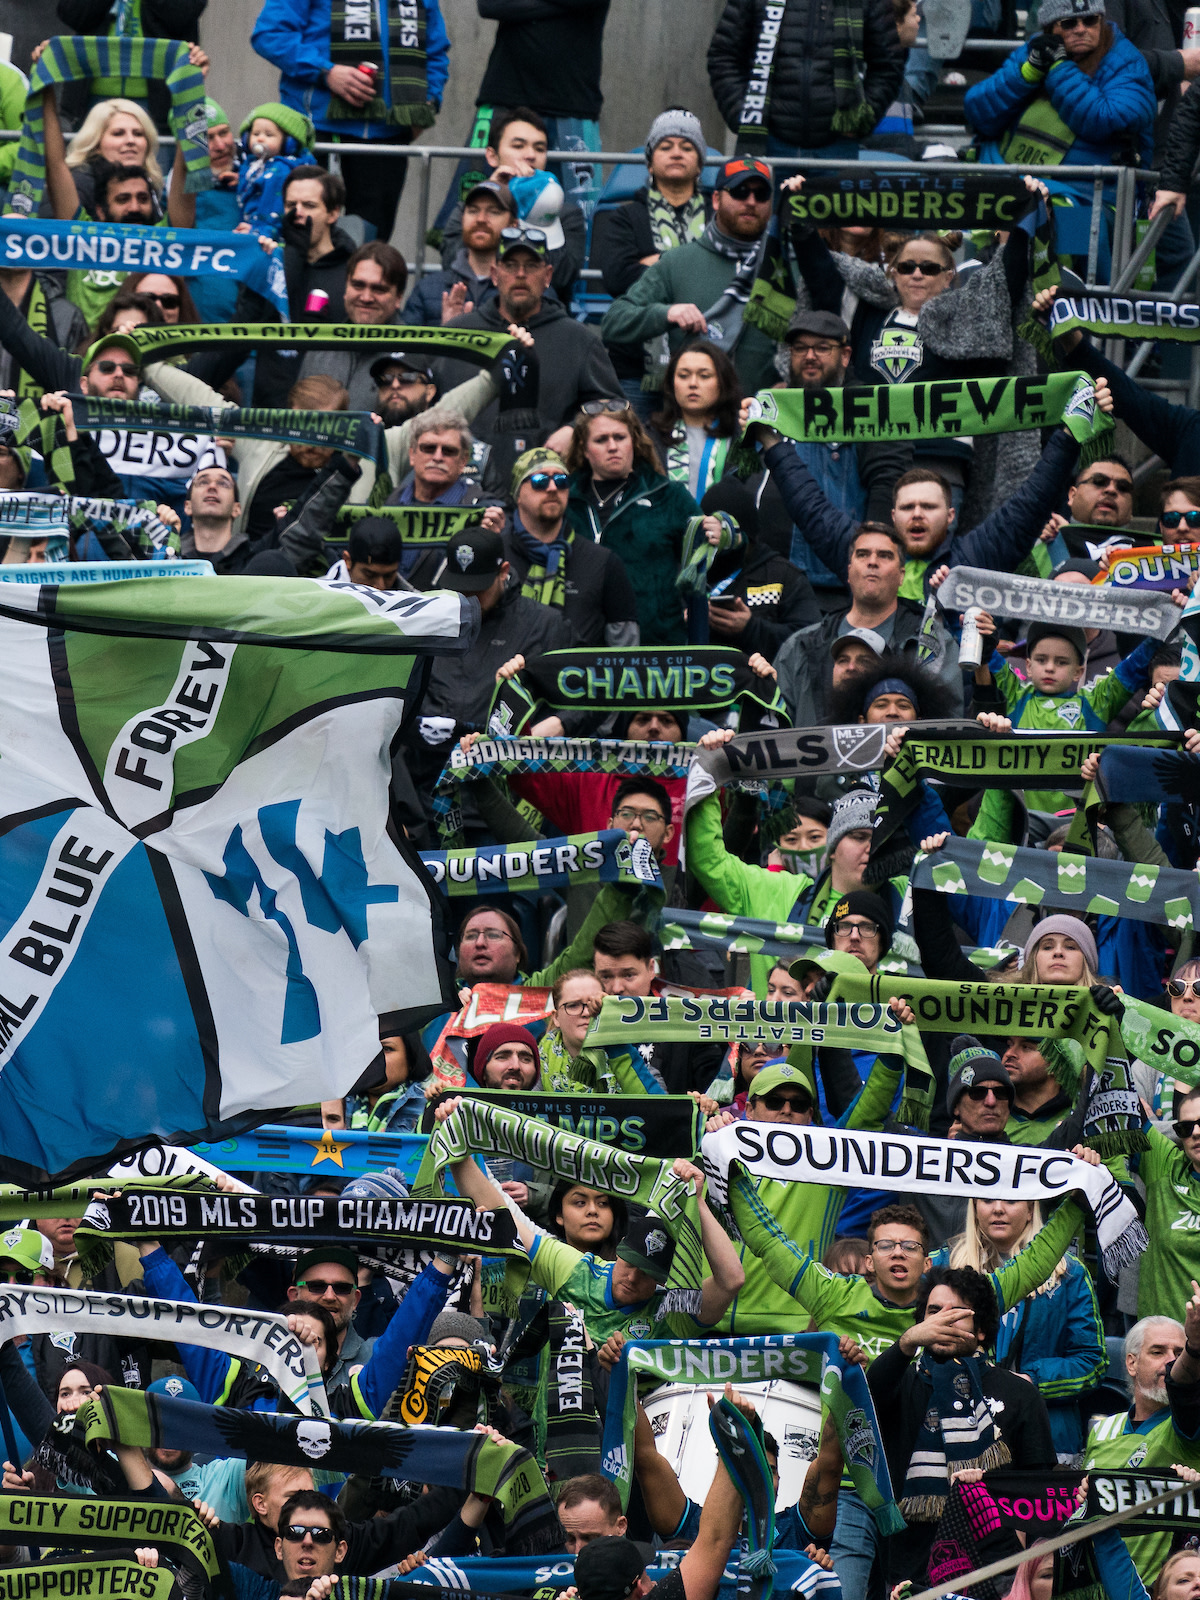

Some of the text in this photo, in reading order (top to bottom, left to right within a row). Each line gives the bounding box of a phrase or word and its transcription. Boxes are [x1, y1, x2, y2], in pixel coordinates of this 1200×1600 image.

[741, 0, 786, 125] PPORTERS
[840, 178, 966, 191] SEATTLE
[787, 192, 1017, 221] SOUNDERS FC
[70, 225, 177, 240] SEATTLE
[4, 233, 238, 272] SOUNDERS FC
[1050, 296, 1200, 330] OUNDERS
[87, 397, 361, 440] DECADE OF DOMINANCE
[803, 375, 1049, 438] BELIEVE
[403, 511, 455, 538] THE
[16, 570, 66, 584] RIGHTS
[70, 569, 99, 582] ARE
[103, 568, 154, 582] HUMAN
[1011, 577, 1108, 601] SEATTLE
[955, 583, 1163, 632] SOUNDERS
[596, 656, 694, 666] 2019 MLS CUP
[557, 665, 737, 700] CHAMPS
[837, 728, 866, 740] MLS
[451, 740, 593, 769] BROUGHAM
[723, 734, 830, 772] MLS
[999, 745, 1051, 769] CITY
[9, 835, 115, 977] BLUE
[958, 983, 1080, 1001] SEATTLE
[620, 997, 903, 1034] FC SOUNDERS
[903, 995, 1111, 1050] SOUNDERS FC
[699, 1025, 827, 1042] SEATTLE
[509, 1102, 607, 1114] 2019 MLS CUP
[322, 1143, 338, 1154] 16
[733, 1126, 1075, 1190] SOUNDERS FC
[128, 1195, 496, 1241] 2019 MLS CUP CHAMPIONS
[8, 1500, 73, 1528] CITY
[79, 1504, 212, 1564] SUPPORTERS
